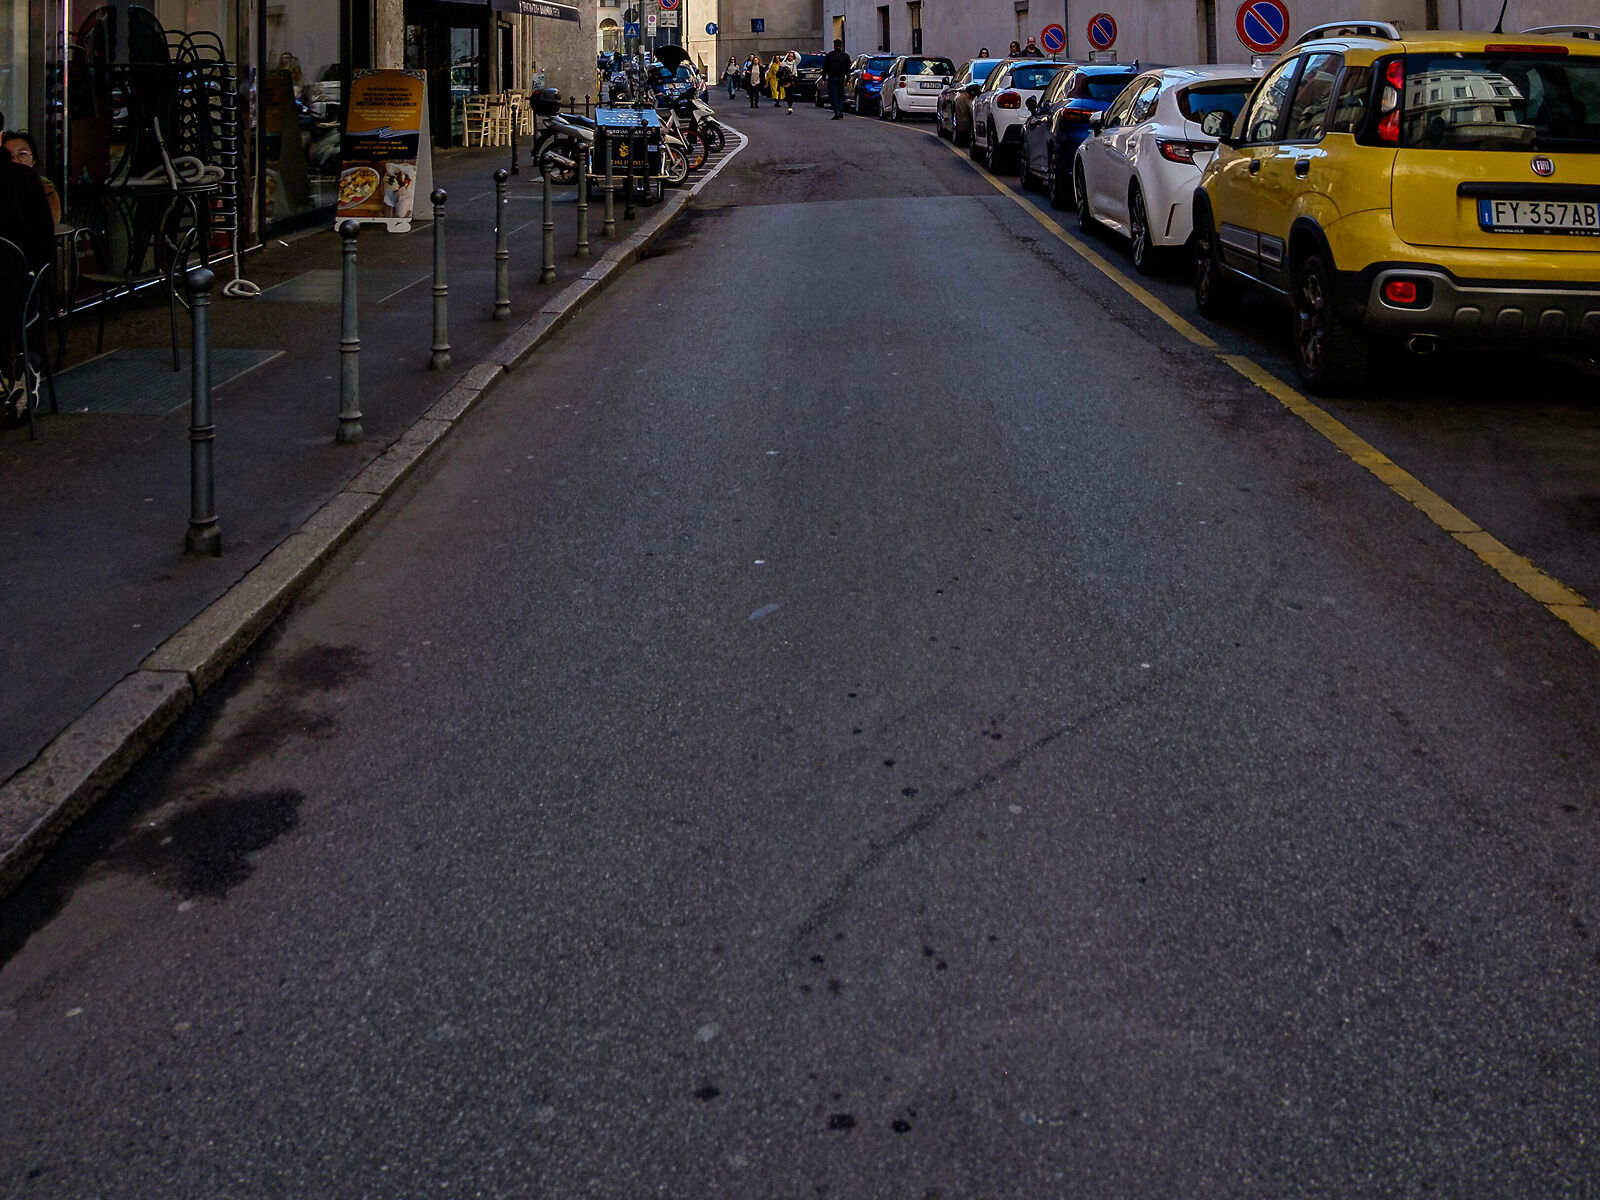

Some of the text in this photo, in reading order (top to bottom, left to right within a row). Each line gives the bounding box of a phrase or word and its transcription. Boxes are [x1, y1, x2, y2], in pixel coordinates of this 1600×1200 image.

[1536, 160, 1550, 170] FIAT
[1495, 202, 1520, 223] FY
[1529, 203, 1596, 226] 357AB
